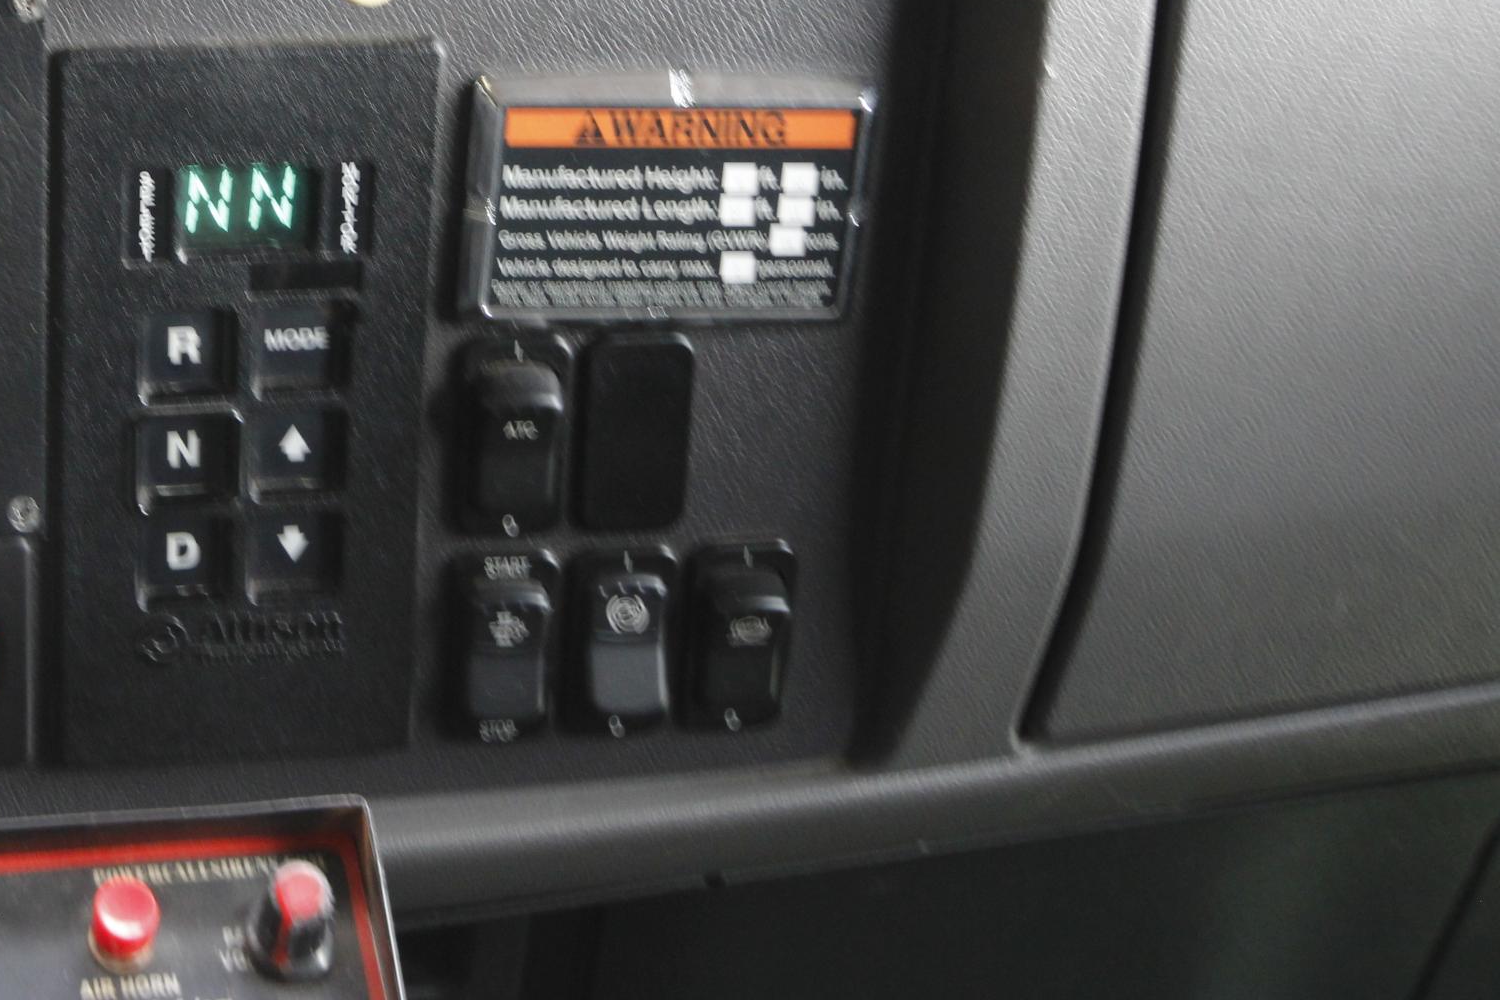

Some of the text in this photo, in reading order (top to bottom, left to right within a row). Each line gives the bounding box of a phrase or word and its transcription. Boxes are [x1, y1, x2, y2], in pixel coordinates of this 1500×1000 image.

[607, 110, 786, 148] WARNING
[502, 164, 644, 190] Manufactured
[500, 195, 640, 220] Manufactured
[546, 229, 603, 250] Vehicle
[602, 229, 657, 253] Weight
[656, 230, 707, 253] Rating
[496, 257, 552, 278] Vehicle
[551, 257, 623, 281] designed
[622, 258, 641, 278] to
[167, 325, 202, 365] R
[263, 326, 331, 352] MODE
[167, 429, 201, 469] N
[167, 531, 201, 571] D
[484, 555, 532, 580] START
[479, 719, 519, 743] STOP
[80, 972, 181, 1000] AIR HORN
